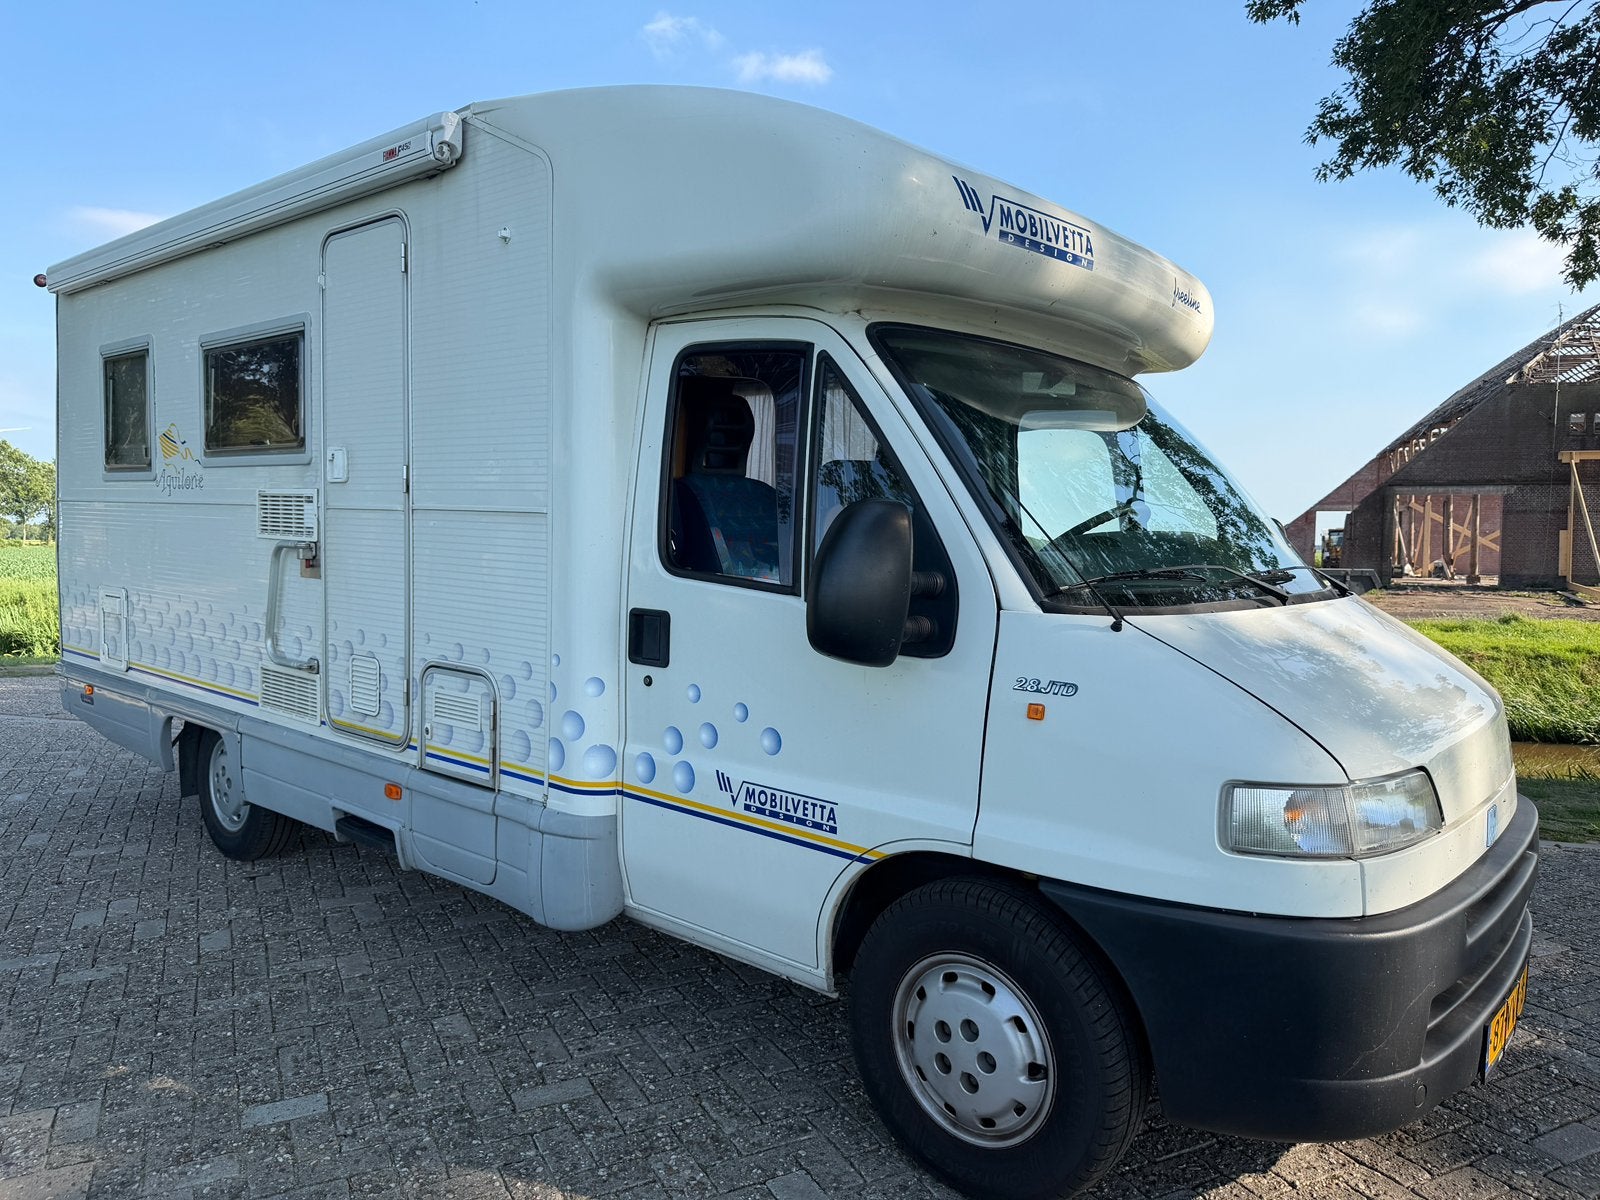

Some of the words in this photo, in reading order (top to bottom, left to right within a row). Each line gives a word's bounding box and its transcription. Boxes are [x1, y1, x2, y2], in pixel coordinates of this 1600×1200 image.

[1000, 203, 1095, 258] MOBILVETTA
[1007, 233, 1089, 267] DESIGN
[1040, 679, 1079, 697] JTD
[744, 786, 837, 825] MOBILVETTA
[750, 806, 830, 832] DESIGN
